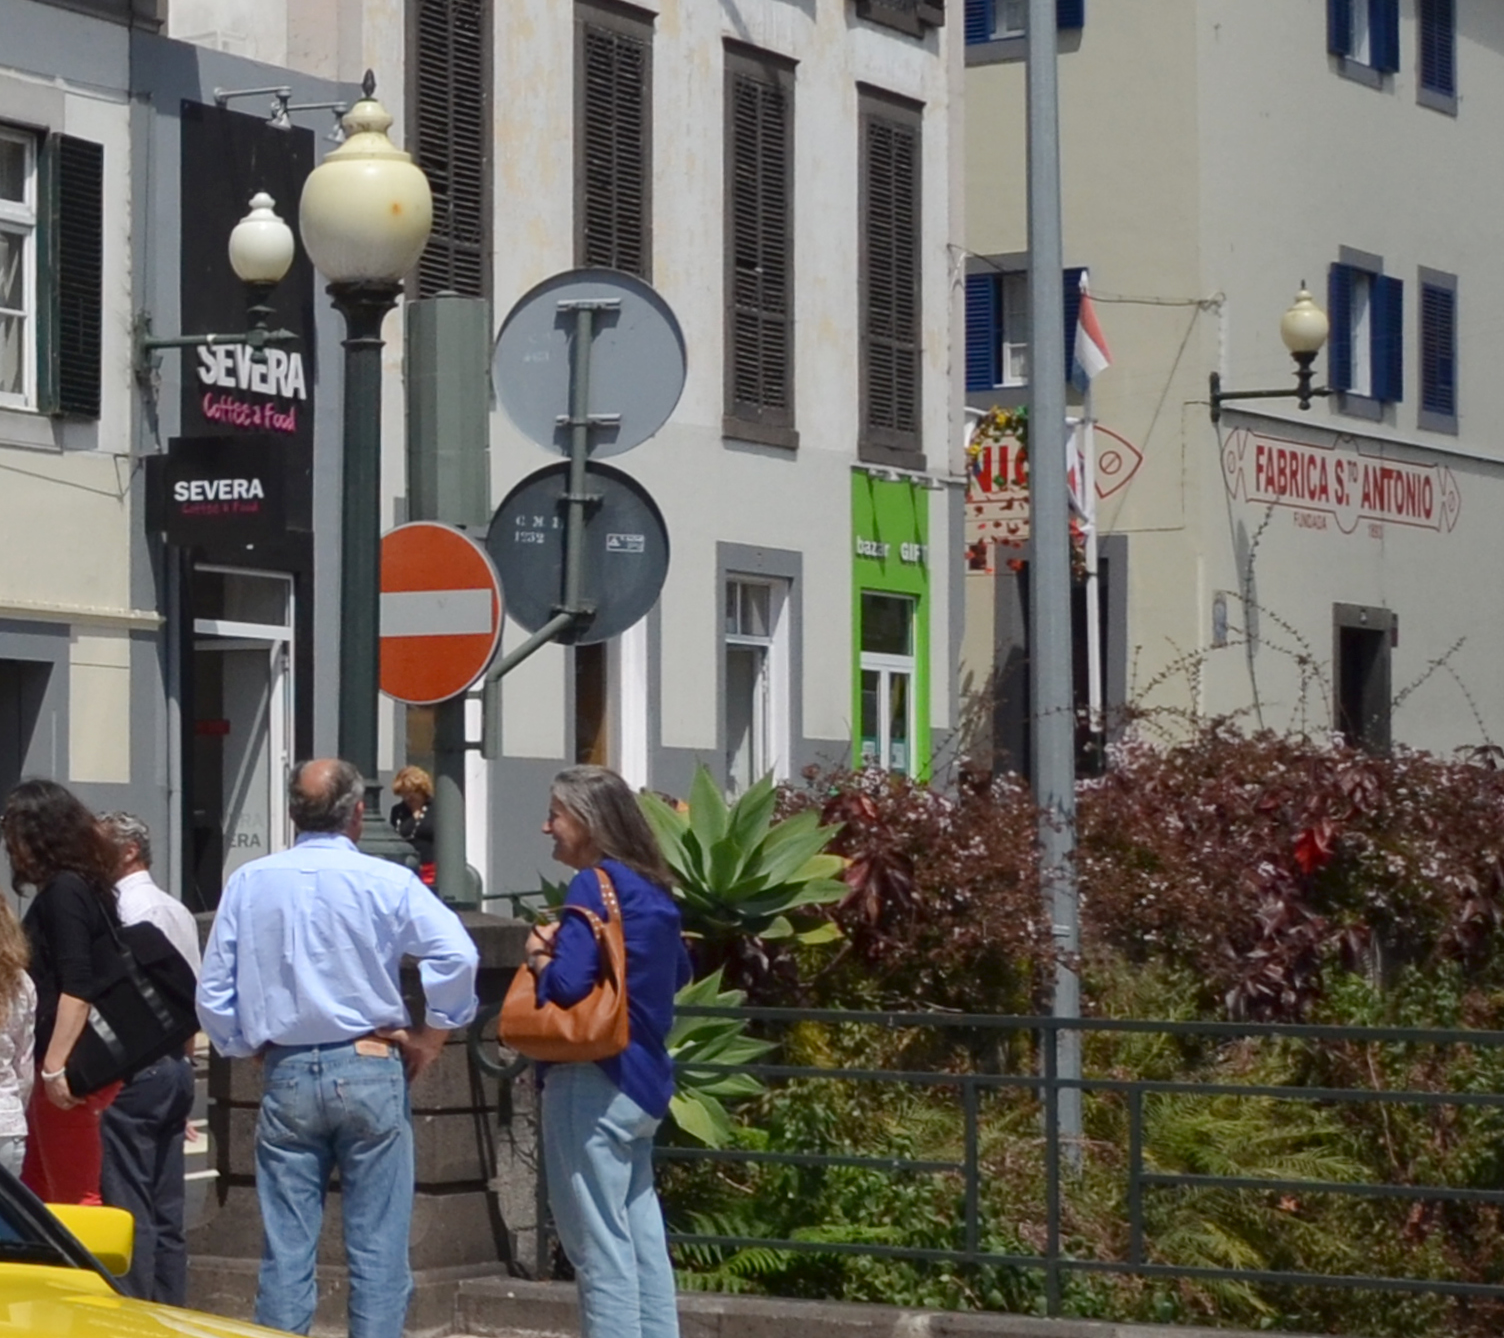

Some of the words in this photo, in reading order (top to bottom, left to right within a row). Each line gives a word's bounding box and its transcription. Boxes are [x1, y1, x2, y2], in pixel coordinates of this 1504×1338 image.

[196, 343, 307, 401] SEVERA
[202, 392, 252, 426] Coffee
[264, 402, 296, 432] Food
[174, 478, 265, 502] SEVERA
[1254, 444, 1330, 504] FABRICA
[1360, 463, 1434, 520] ANTONIO
